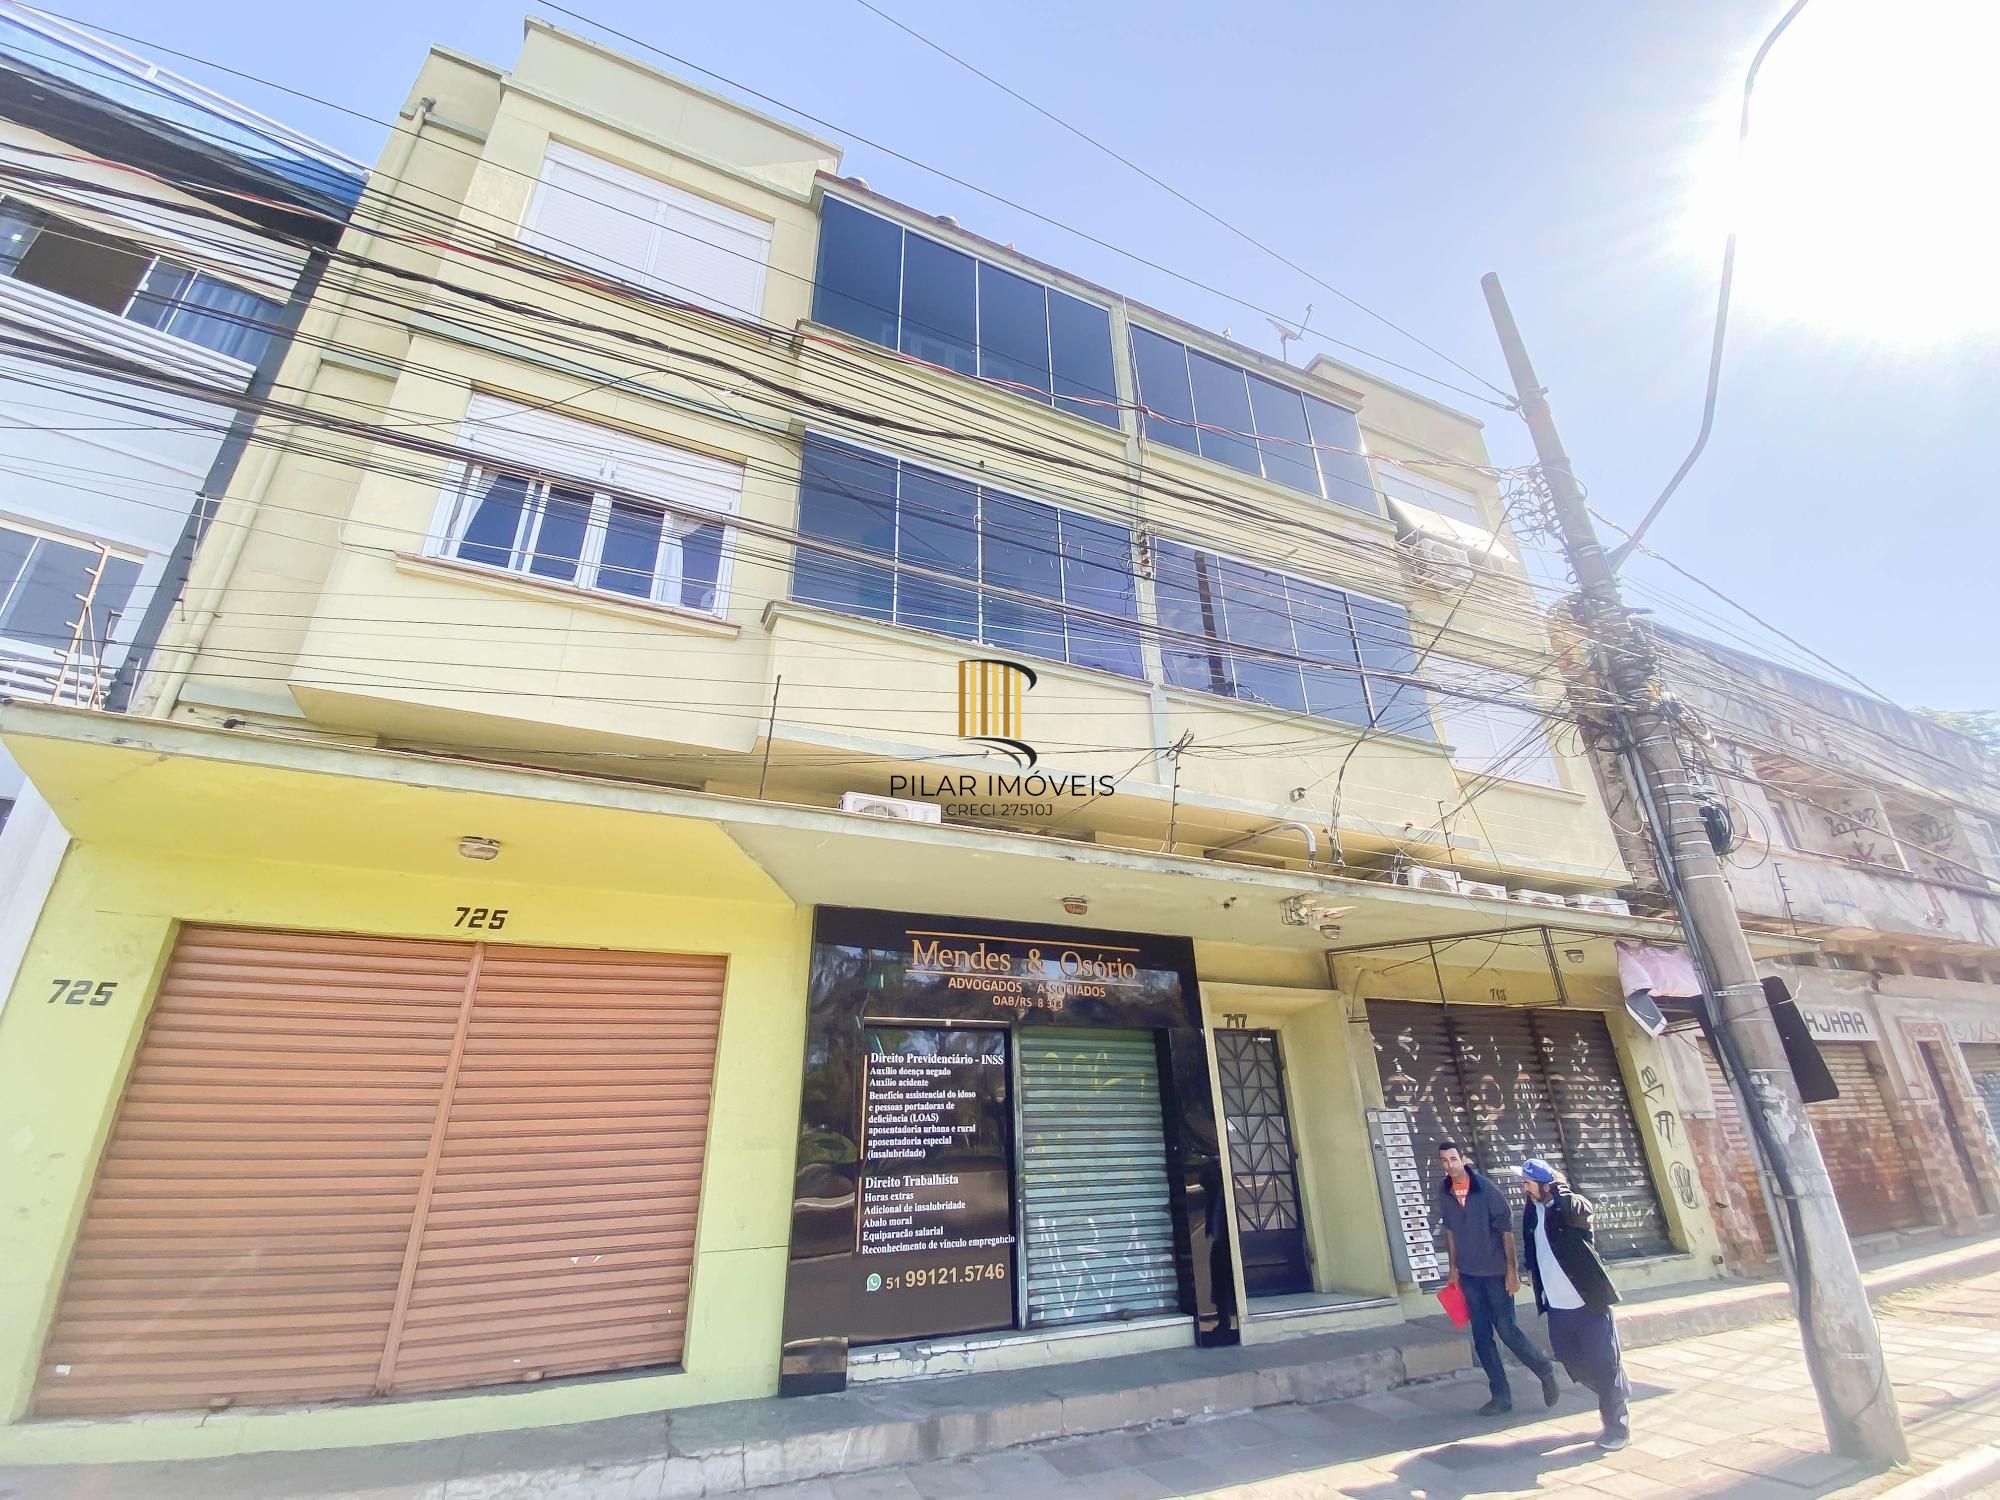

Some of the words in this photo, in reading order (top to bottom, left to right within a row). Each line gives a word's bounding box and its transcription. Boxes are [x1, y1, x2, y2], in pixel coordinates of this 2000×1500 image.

[454, 906, 509, 930] 725
[912, 939, 1011, 971] Mendes
[1027, 949, 1045, 974] &
[1060, 951, 1137, 980] Osório
[47, 979, 118, 1007] 725
[948, 977, 1022, 993] ADVOGADOS
[1037, 983, 1106, 997] ASSOCIADOS
[993, 995, 1032, 1009] OAB/RS
[1222, 1013, 1248, 1029] 717
[870, 1053, 904, 1063] Direito
[906, 1053, 973, 1064] Previdenciário
[981, 1054, 1004, 1065] INSS
[869, 1066, 897, 1075] Auxílio
[898, 1067, 924, 1077] doença
[926, 1067, 951, 1077] negado
[869, 1078, 897, 1087] Auxílio
[898, 1078, 929, 1087] acidente
[905, 1089, 946, 1099] assistencial
[947, 1089, 956, 1098] do
[958, 1089, 976, 1098] idoso
[875, 1103, 903, 1114] pessoas
[904, 1101, 944, 1113] portadoras
[946, 1101, 955, 1110] de
[868, 1114, 908, 1124] deficiência
[909, 1113, 939, 1123] (LOAS)
[868, 1124, 921, 1136] aposentadoria
[923, 1124, 950, 1133] urbana
[957, 1123, 976, 1132] rural
[868, 1136, 921, 1147] aposentadoria
[923, 1135, 952, 1147] especial
[867, 1149, 926, 1160] (insalubridade)
[865, 1177, 901, 1189] Direito
[902, 1174, 959, 1187] Trabalhista
[864, 1192, 889, 1203] Horas
[890, 1191, 914, 1201] extras
[863, 1203, 902, 1215] Adicional
[903, 1202, 913, 1212] de
[914, 1200, 966, 1212] insalubridade
[863, 1217, 888, 1228] Abalo
[889, 1215, 913, 1226] moral
[914, 1226, 944, 1236] salarial
[861, 1240, 927, 1255] Reconhecimento
[928, 1239, 938, 1250] de
[939, 1237, 967, 1248] vínculo
[885, 1276, 900, 1290] 51
[905, 1263, 1005, 1288] 99121.5746
